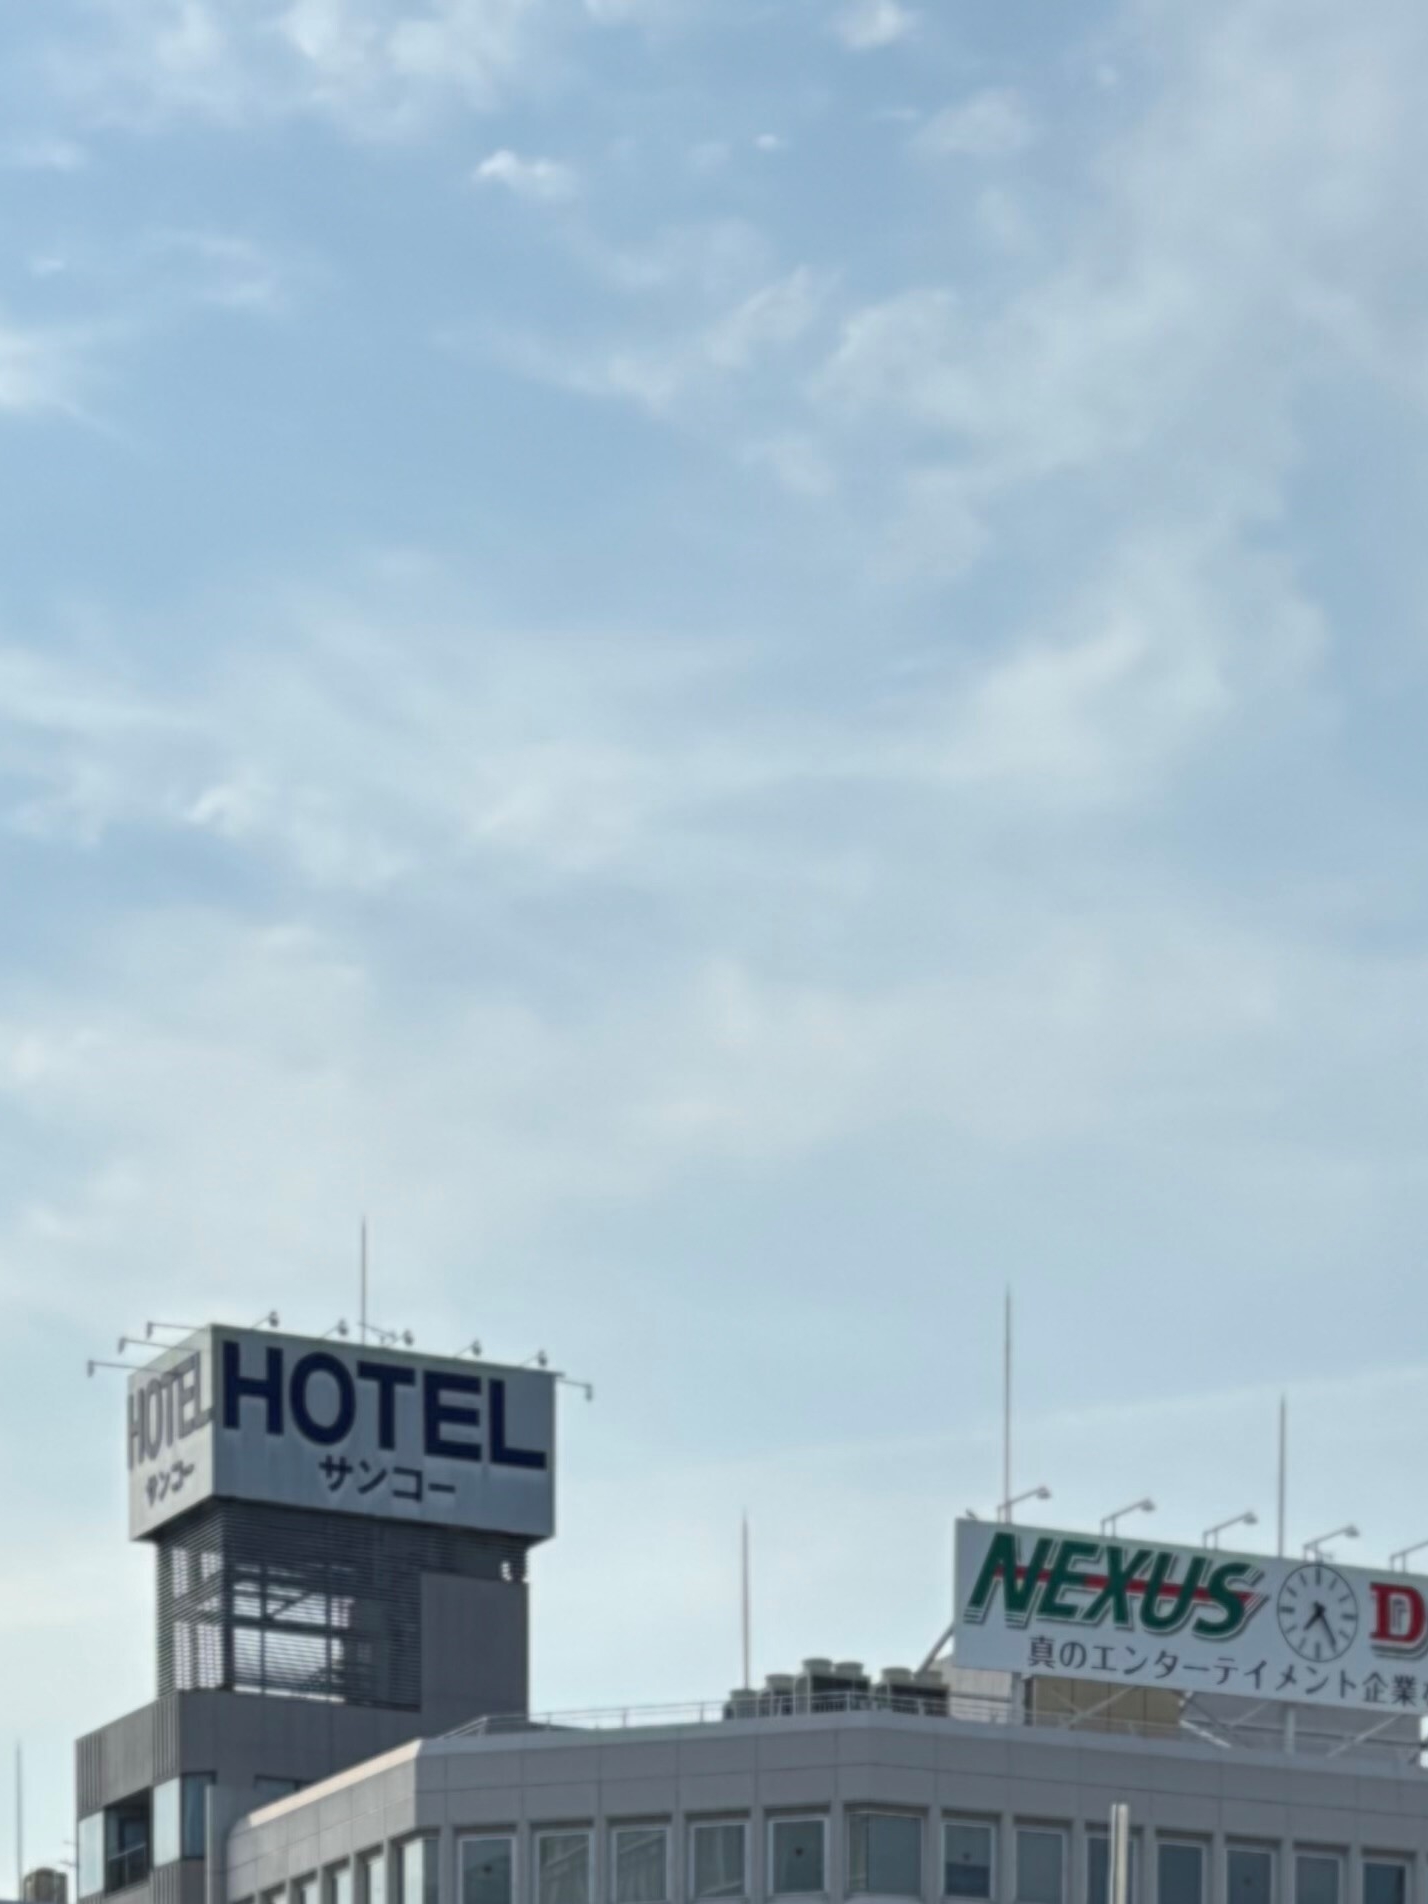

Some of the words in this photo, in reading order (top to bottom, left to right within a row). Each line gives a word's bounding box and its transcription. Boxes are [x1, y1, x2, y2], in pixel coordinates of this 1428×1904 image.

[128, 1351, 215, 1471] HOTEL
[223, 1341, 547, 1470] HOTEL
[319, 1454, 456, 1501] サンコー
[963, 1532, 1269, 1642] NEXUS
